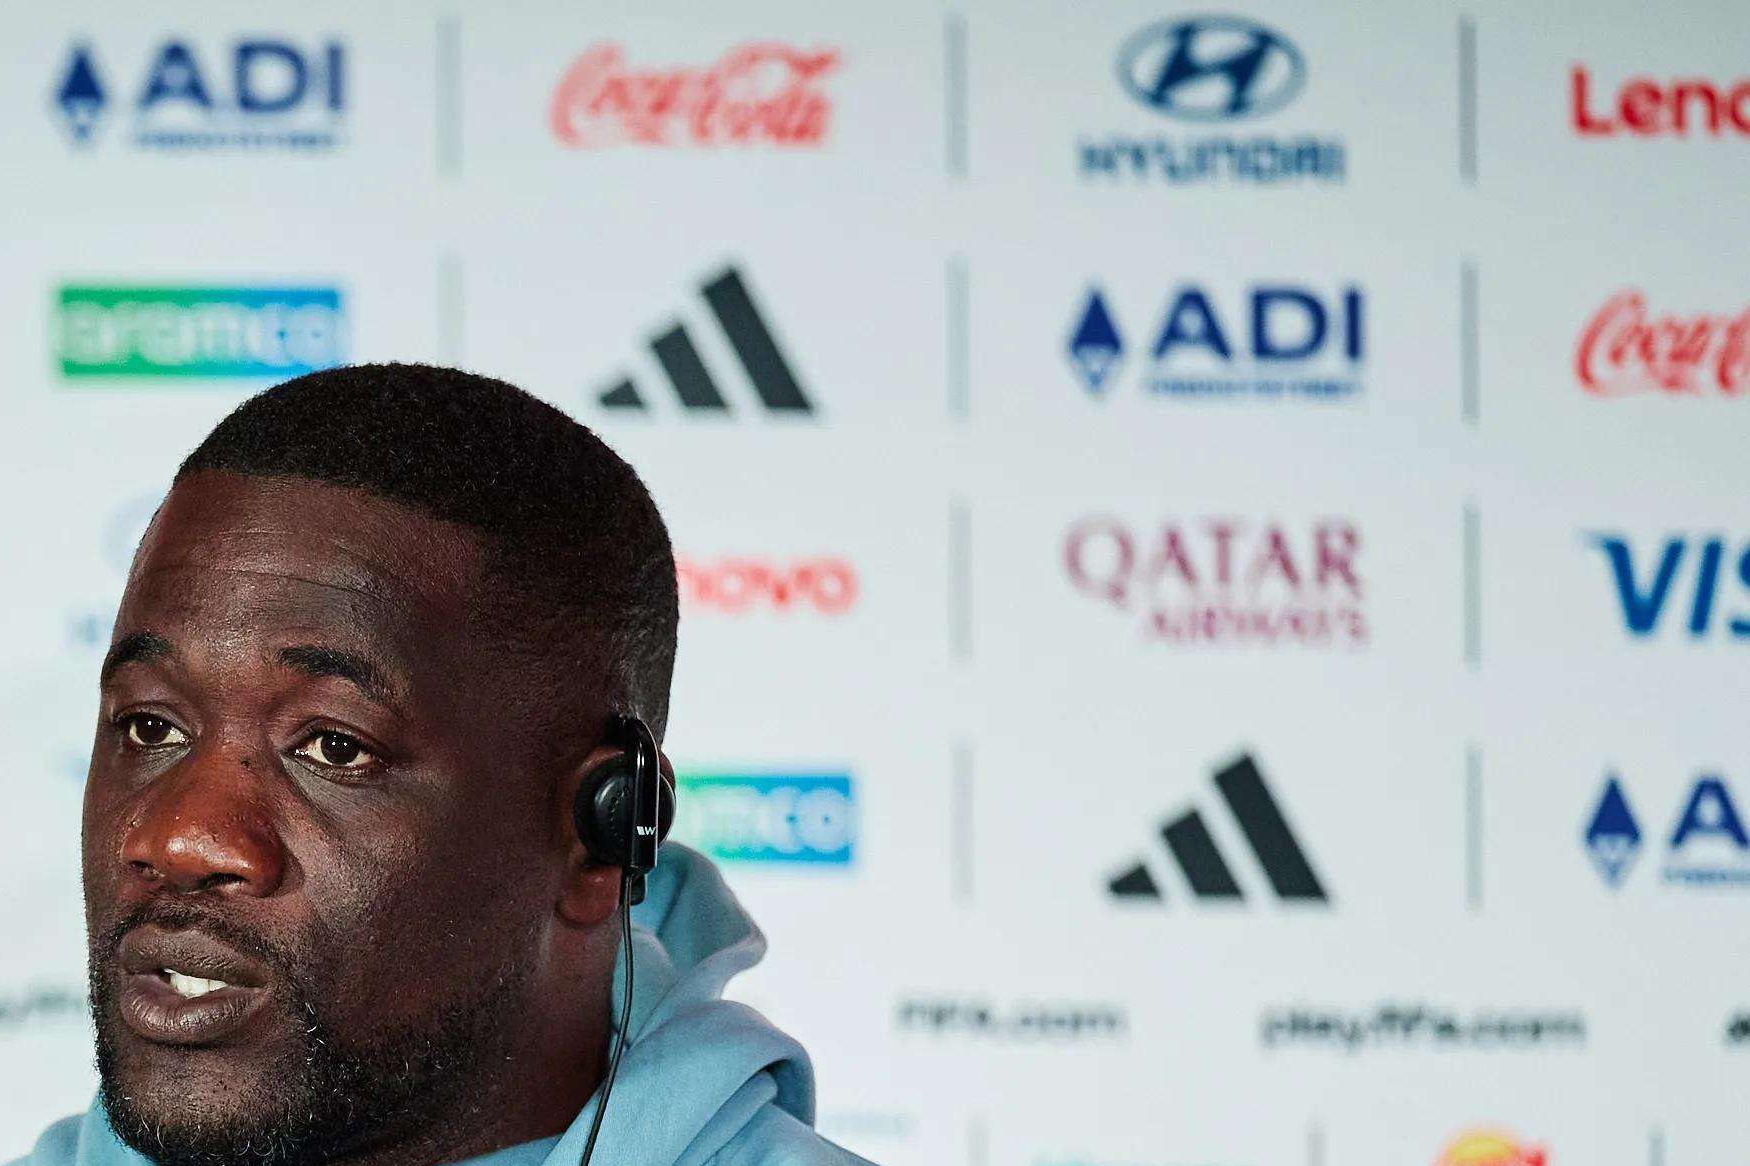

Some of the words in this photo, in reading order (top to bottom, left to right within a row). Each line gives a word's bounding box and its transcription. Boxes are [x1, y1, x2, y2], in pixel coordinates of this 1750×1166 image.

[137, 38, 346, 113] ADI
[1079, 136, 1346, 184] HYUNDAI
[1151, 286, 1365, 363] ADI
[1061, 517, 1362, 607] QATAR
